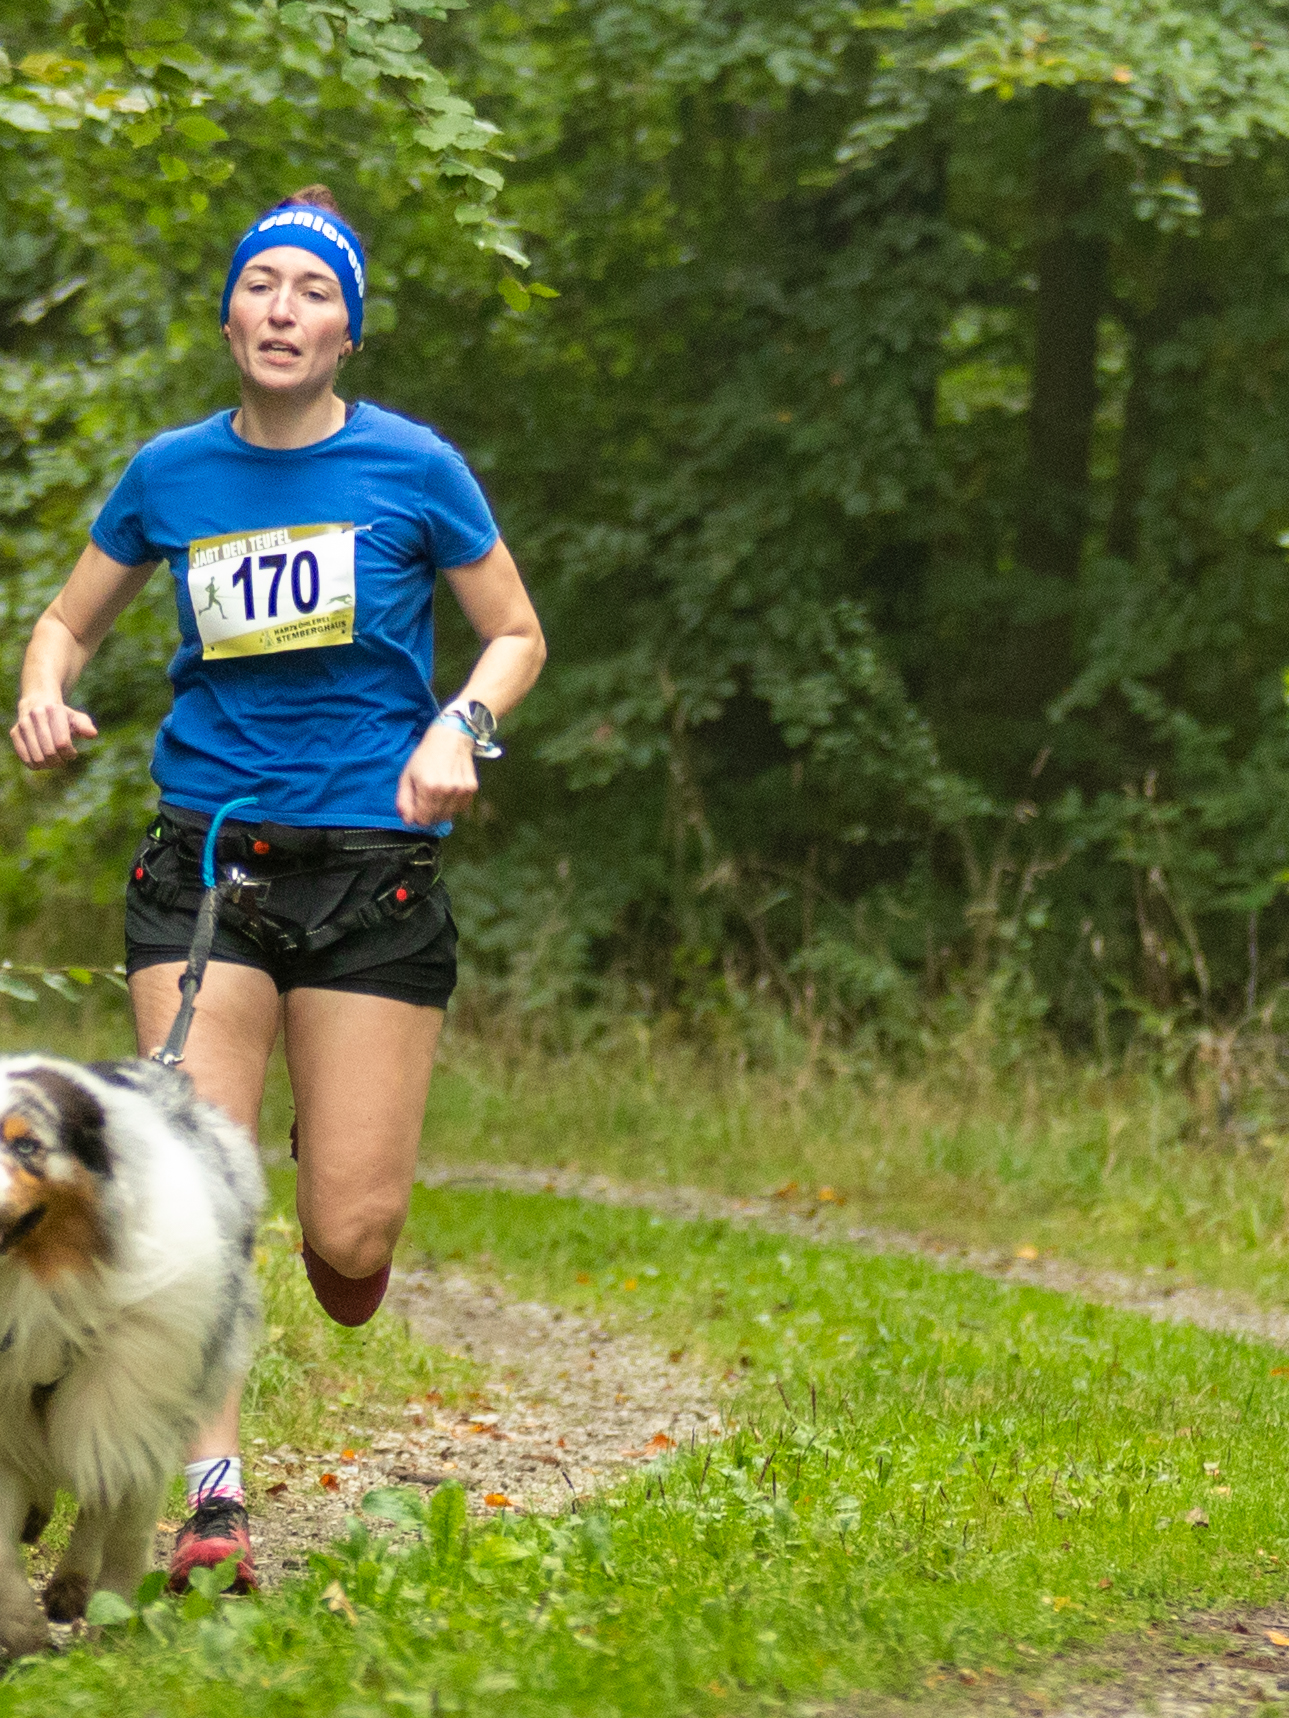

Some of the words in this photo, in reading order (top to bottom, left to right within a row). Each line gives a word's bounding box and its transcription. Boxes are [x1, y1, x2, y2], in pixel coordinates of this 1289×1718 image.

[192, 546, 220, 568] JAGT
[221, 539, 247, 559] DEN
[248, 528, 292, 552] TEUFEL
[232, 550, 320, 621] 170
[275, 620, 347, 643] STEMBERGHAUS
